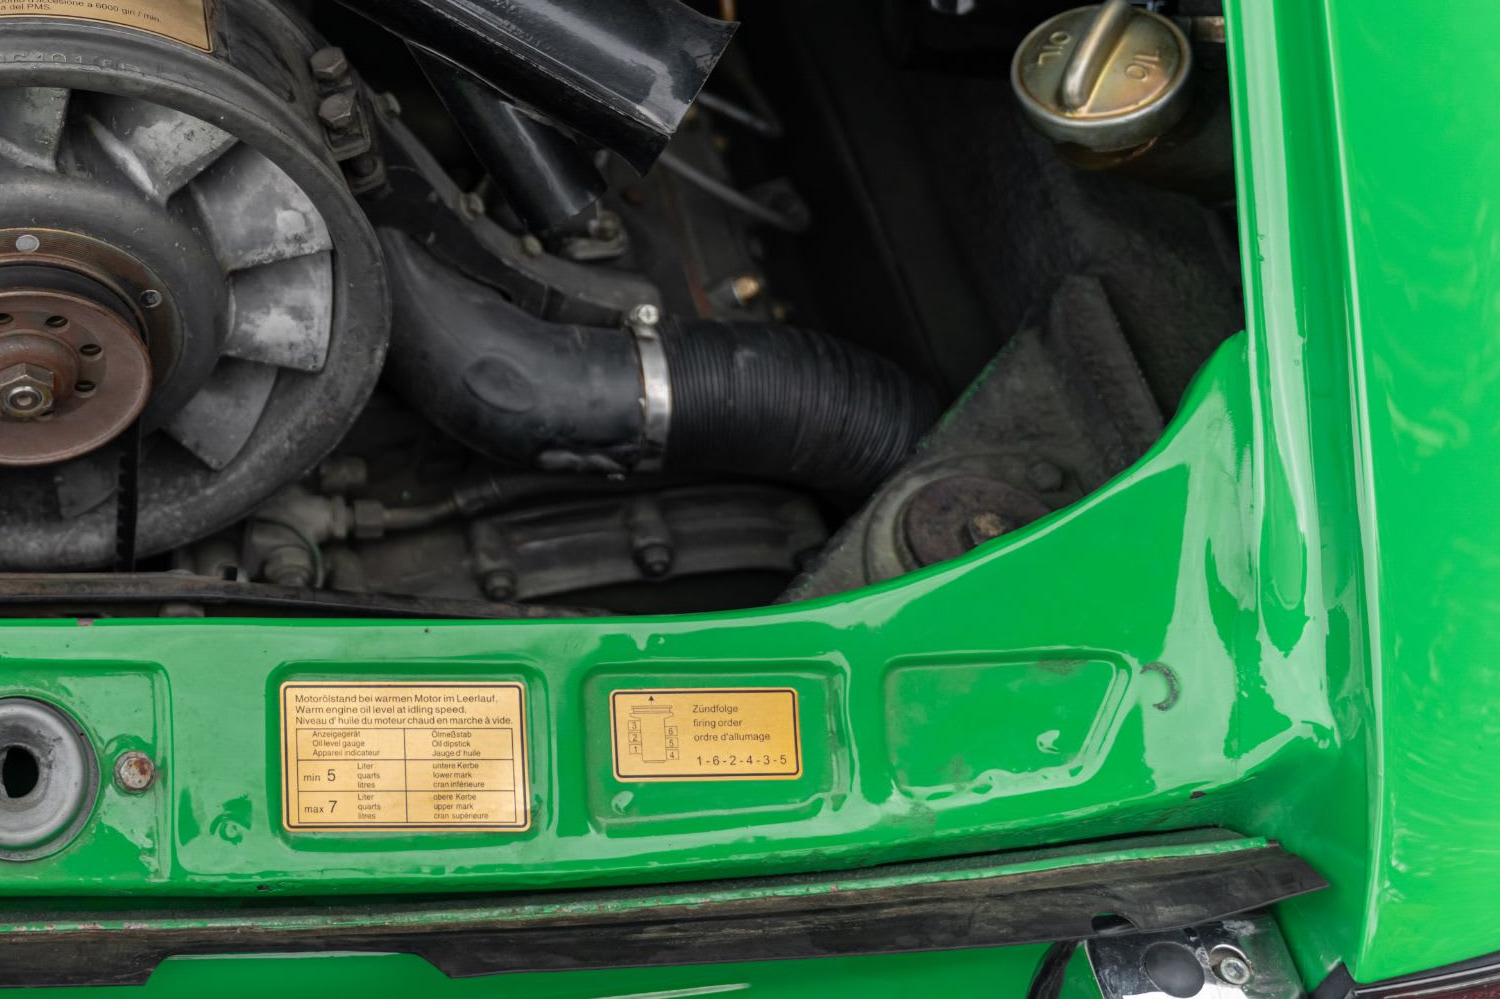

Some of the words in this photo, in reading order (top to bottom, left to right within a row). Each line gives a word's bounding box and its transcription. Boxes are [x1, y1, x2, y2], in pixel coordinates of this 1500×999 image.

[95, 3, 119, 12] 6000
[1038, 31, 1071, 66] OIL
[1124, 50, 1161, 82] OIL
[296, 695, 356, 703] Motorölstand
[359, 695, 372, 703] bei
[374, 695, 412, 703] warmen
[415, 695, 442, 703] Motor
[444, 695, 454, 703] im
[296, 706, 324, 714] Warm
[325, 706, 358, 715] engine
[360, 706, 370, 714] oil
[373, 706, 394, 714] level
[396, 706, 406, 714] at
[408, 706, 433, 716] idling
[435, 706, 466, 716] speed.
[693, 705, 738, 714] Zündfolge
[296, 717, 328, 725] Niveau
[339, 717, 360, 725] huile
[362, 717, 372, 725] du
[408, 717, 435, 725] chaud
[450, 717, 482, 725] marche
[485, 717, 490, 725] à
[493, 717, 512, 725] vide.
[694, 719, 716, 729] firing
[718, 719, 742, 727] order
[694, 733, 718, 741] ordre
[720, 733, 770, 742] d'allumage
[343, 741, 365, 749] gauge
[444, 740, 470, 748] dipstick
[669, 739, 673, 747] 5
[313, 749, 342, 758] Appareil
[344, 749, 380, 757] indicateur
[432, 750, 455, 758] Jauge
[464, 749, 480, 757] huile
[304, 774, 320, 782] min
[328, 770, 335, 781] 5
[433, 793, 453, 801] obere
[328, 801, 337, 813] 7
